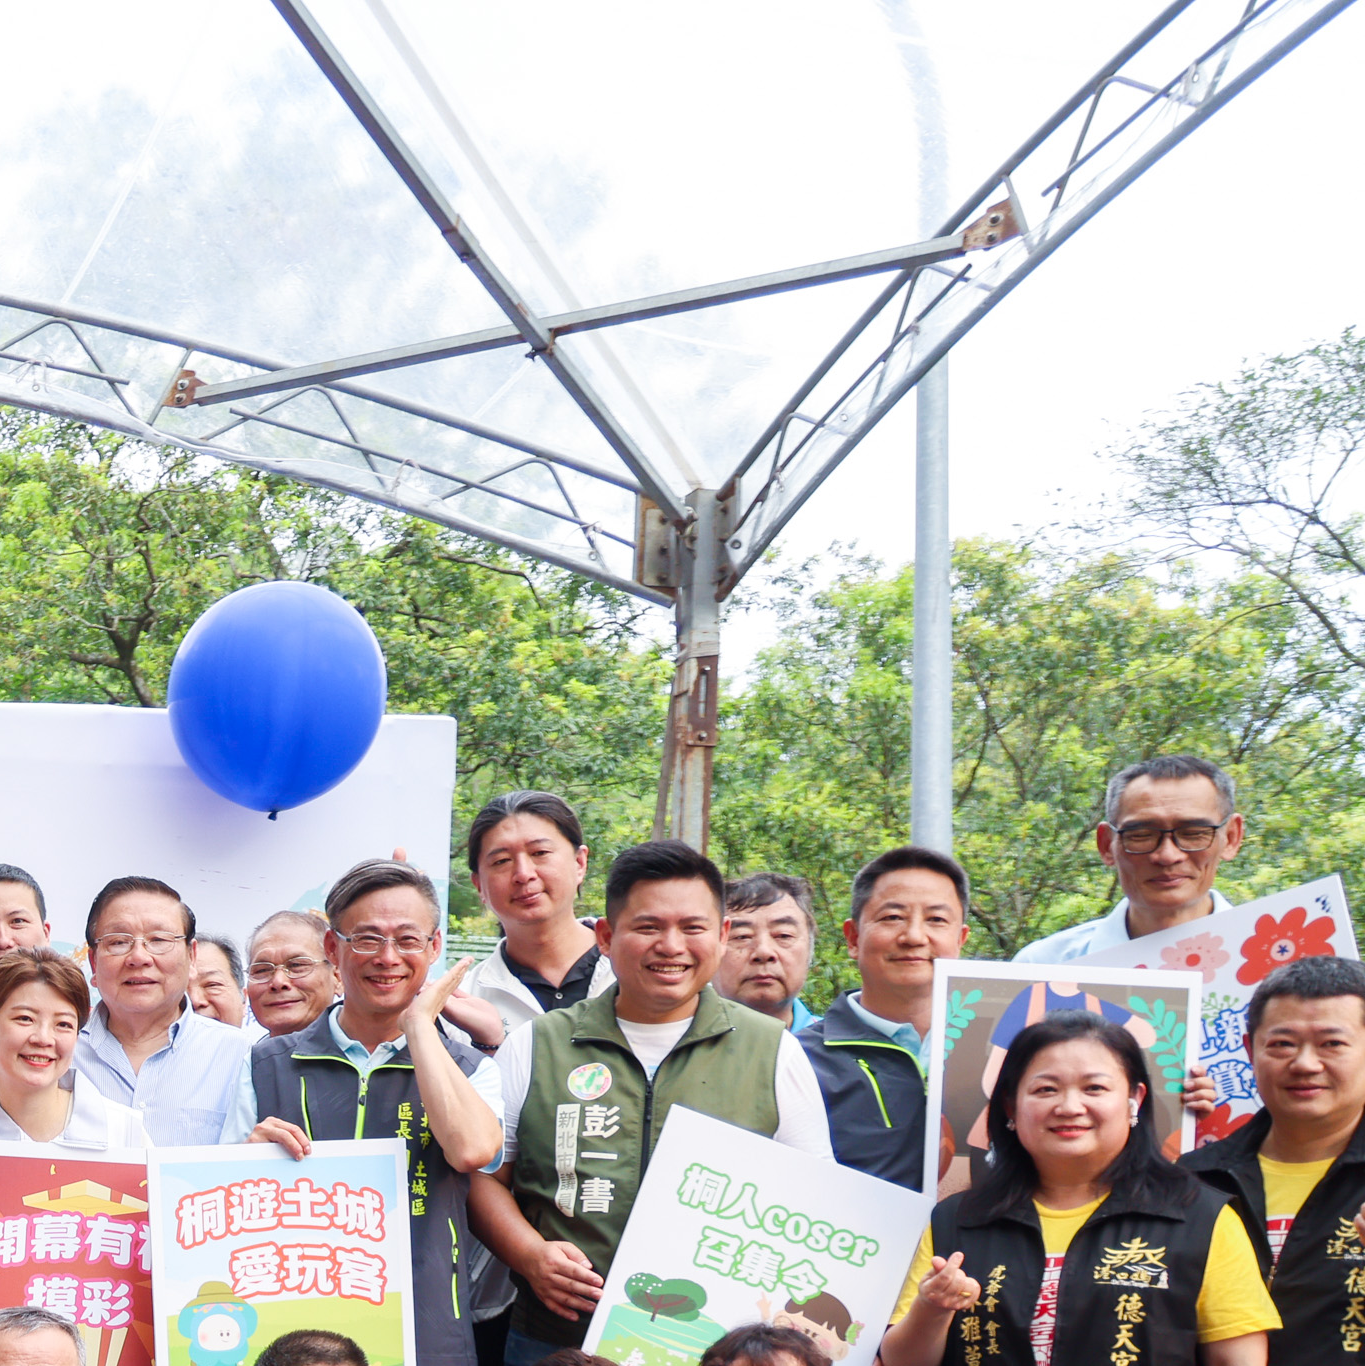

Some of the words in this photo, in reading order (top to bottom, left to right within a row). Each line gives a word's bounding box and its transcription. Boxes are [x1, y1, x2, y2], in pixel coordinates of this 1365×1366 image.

[395, 1102, 414, 1140] 區長
[579, 1104, 620, 1213] 彭一書
[557, 1110, 577, 1210] 新北市議員
[177, 1177, 385, 1248] 桐遊土城
[677, 1163, 879, 1267] 桐人coser
[231, 1243, 387, 1305] 愛玩客
[694, 1226, 828, 1305] 召集令
[984, 1321, 1001, 1355] 會長
